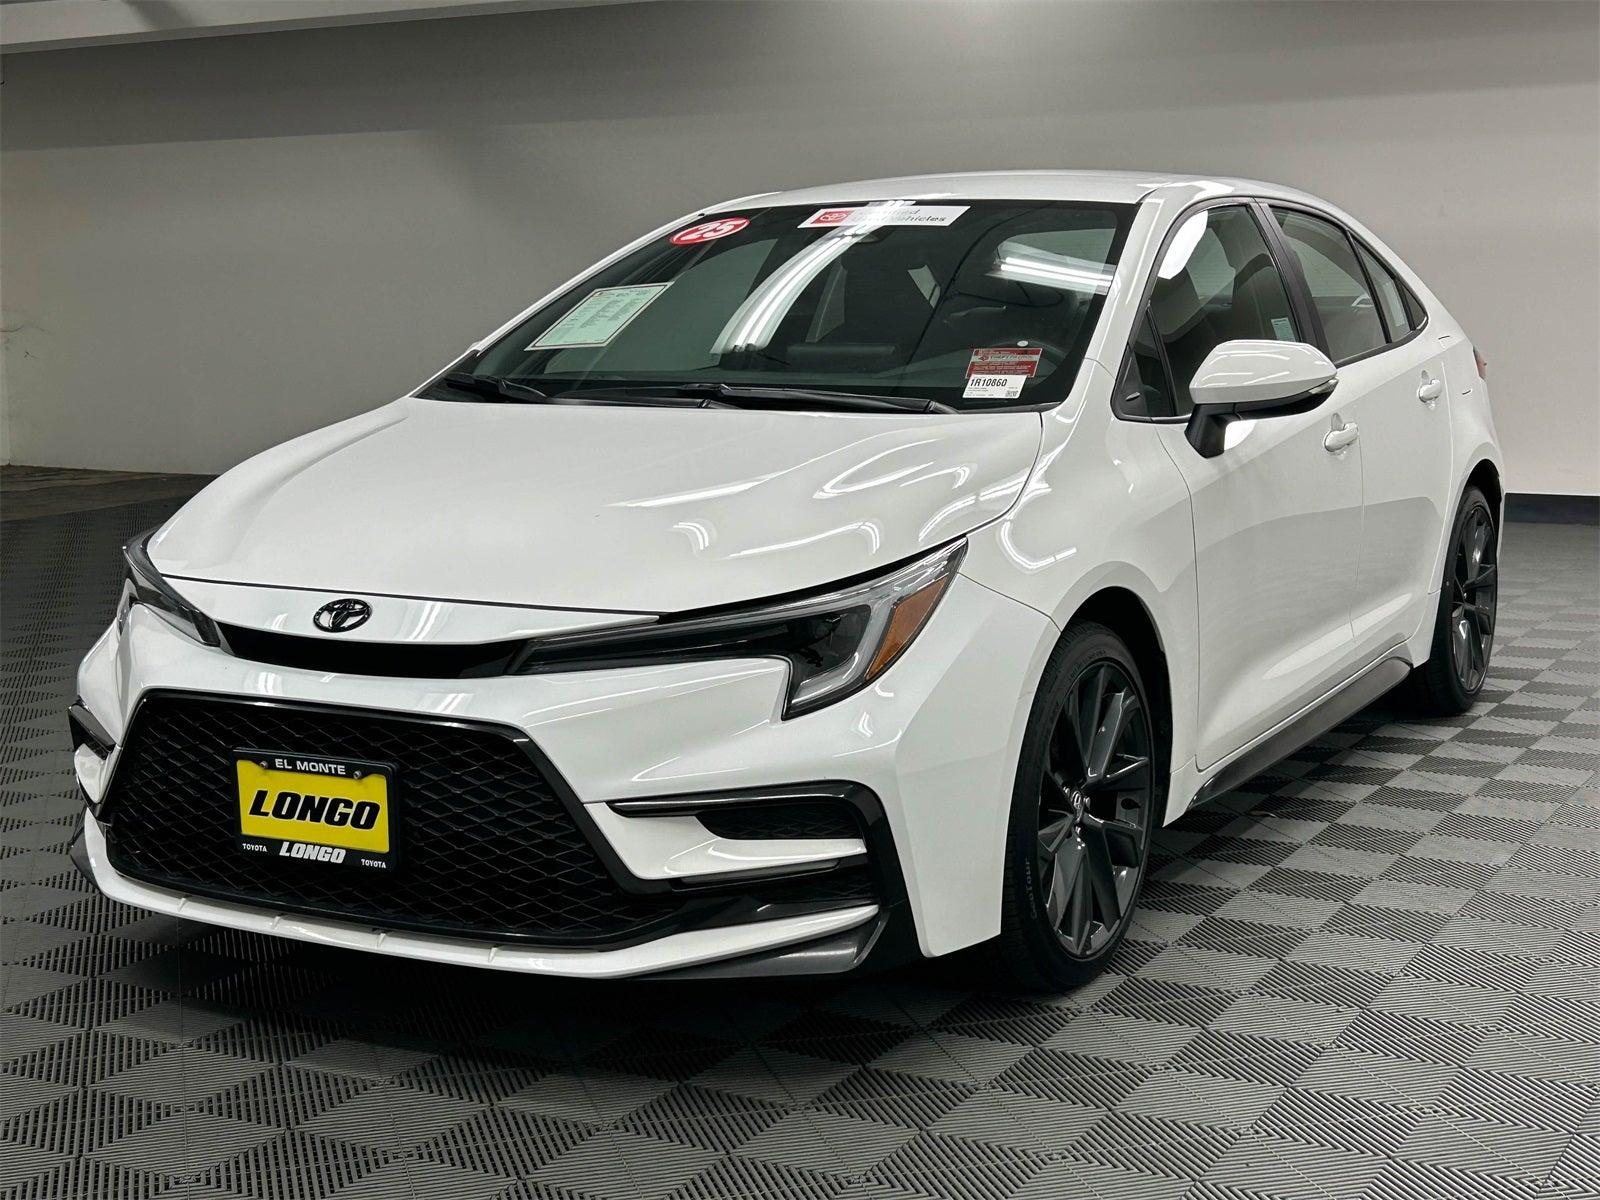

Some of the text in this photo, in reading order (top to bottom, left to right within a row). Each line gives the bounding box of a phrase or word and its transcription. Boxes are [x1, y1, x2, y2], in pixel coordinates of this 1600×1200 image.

[970, 378, 1008, 387] 1R10860
[275, 758, 346, 775] EL MONTE
[249, 790, 380, 830] LONGO
[242, 843, 268, 853] TOYOTA
[279, 841, 346, 864] LONGO
[361, 858, 387, 869] TOYOTA
